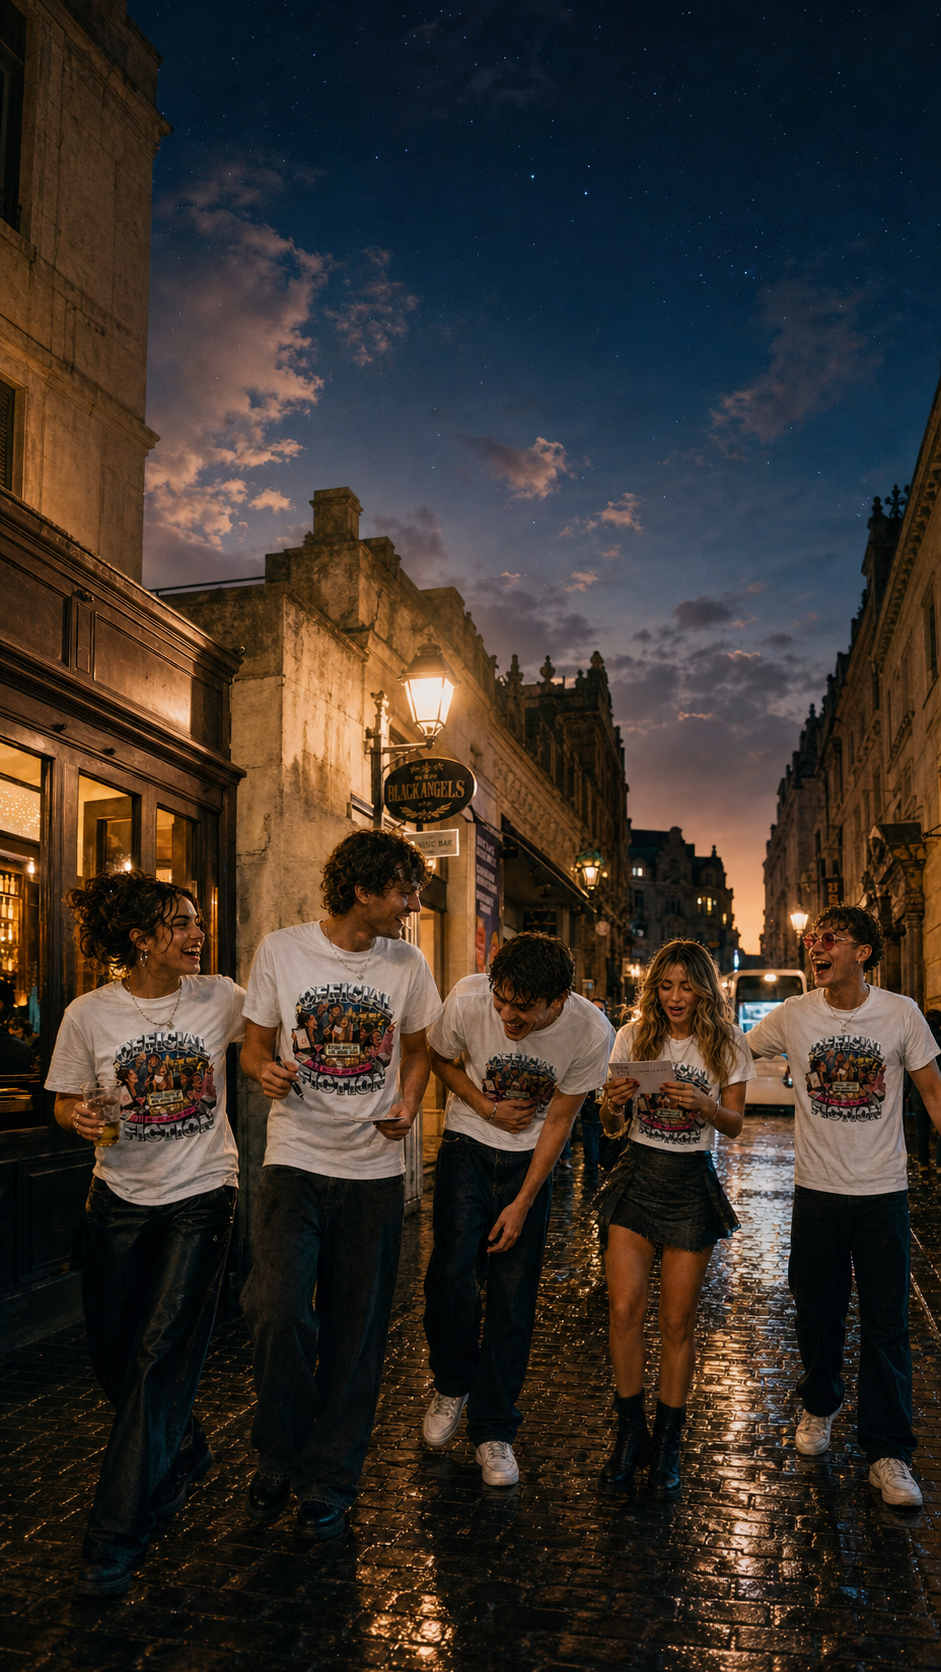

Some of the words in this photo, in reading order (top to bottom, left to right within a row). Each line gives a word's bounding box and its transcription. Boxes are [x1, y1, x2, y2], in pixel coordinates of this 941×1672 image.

[438, 839, 453, 848] BAR
[298, 982, 395, 1019] OFFICIAL
[115, 1031, 211, 1066] OFFICIAL
[811, 1034, 885, 1062] OFFICIAL
[297, 1064, 386, 1095] FICTION
[811, 1099, 883, 1122] FICTION
[123, 1113, 215, 1143] FICTION
